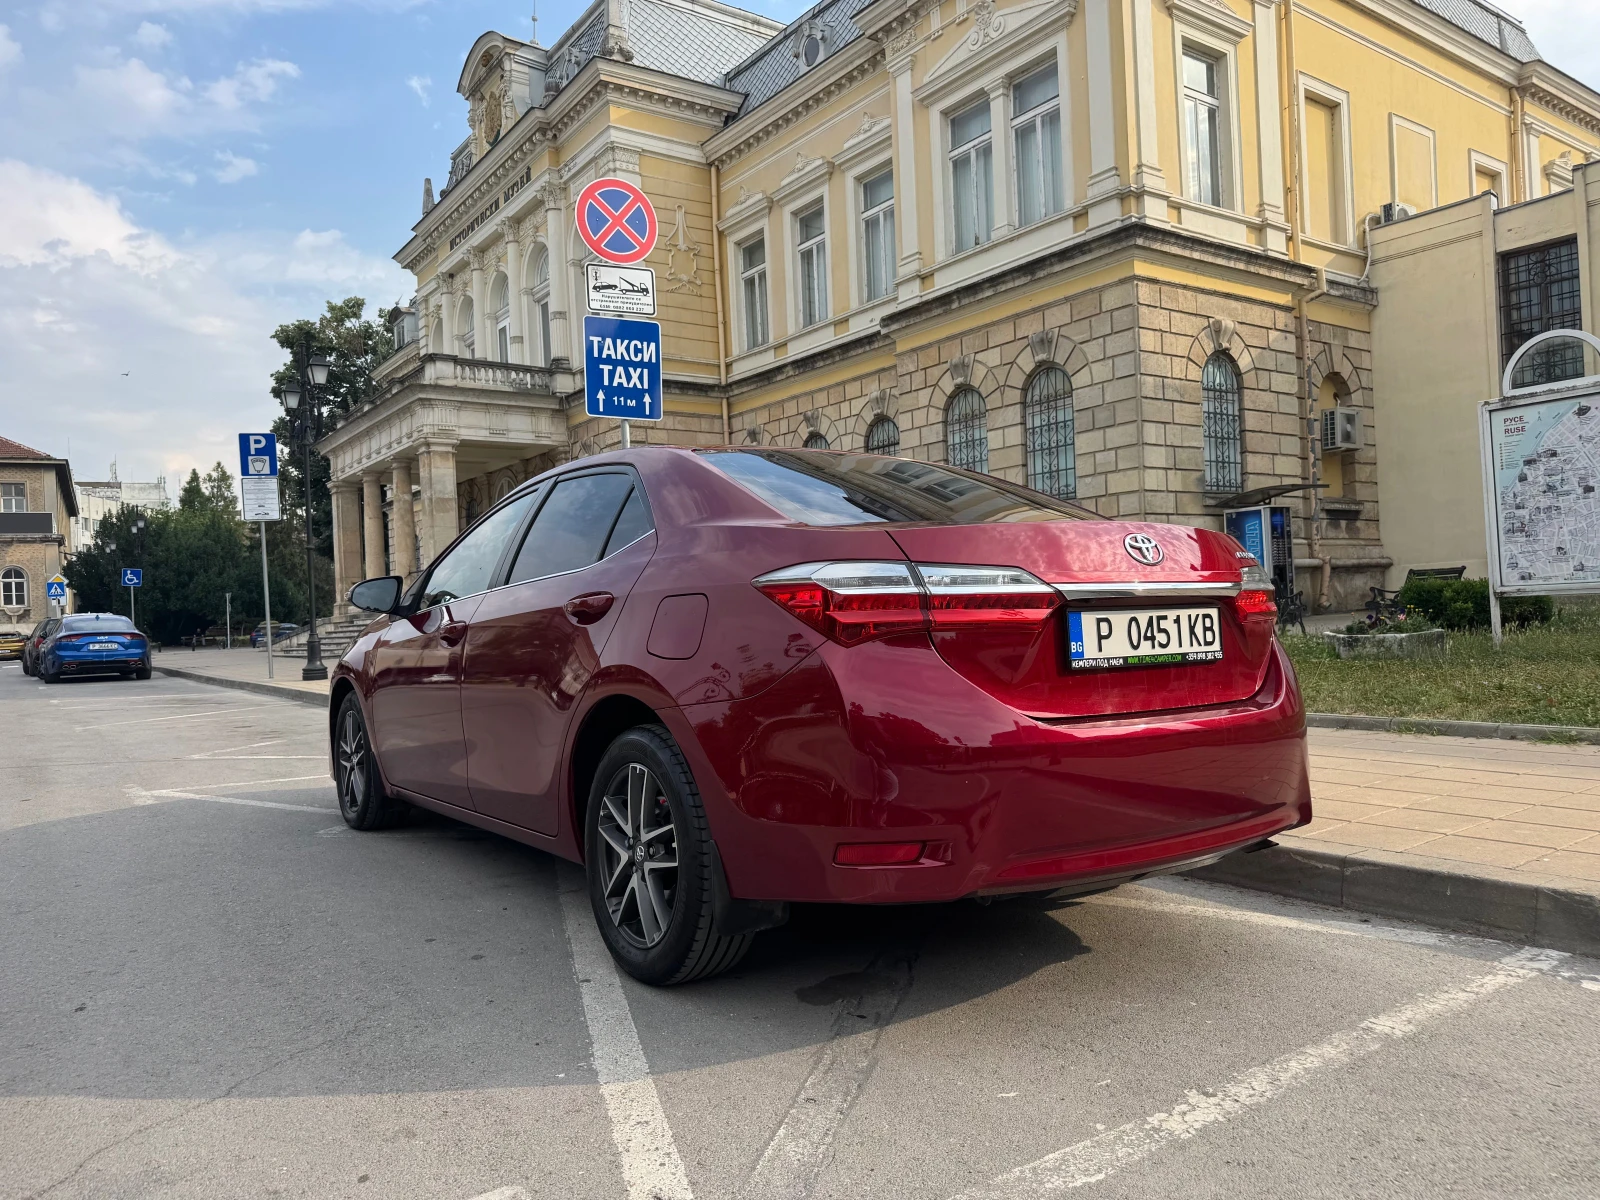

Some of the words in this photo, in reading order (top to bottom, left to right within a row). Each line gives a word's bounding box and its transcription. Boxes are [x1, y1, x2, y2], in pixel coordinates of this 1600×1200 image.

[589, 336, 656, 363] ТАКСИ
[599, 364, 648, 390] TAXI
[1504, 415, 1524, 424] РУСЕ
[1504, 426, 1526, 434] RUSE
[250, 435, 266, 455] P
[1096, 616, 1113, 652] P
[1071, 642, 1082, 652] BG
[1097, 659, 1108, 667] ПОД
